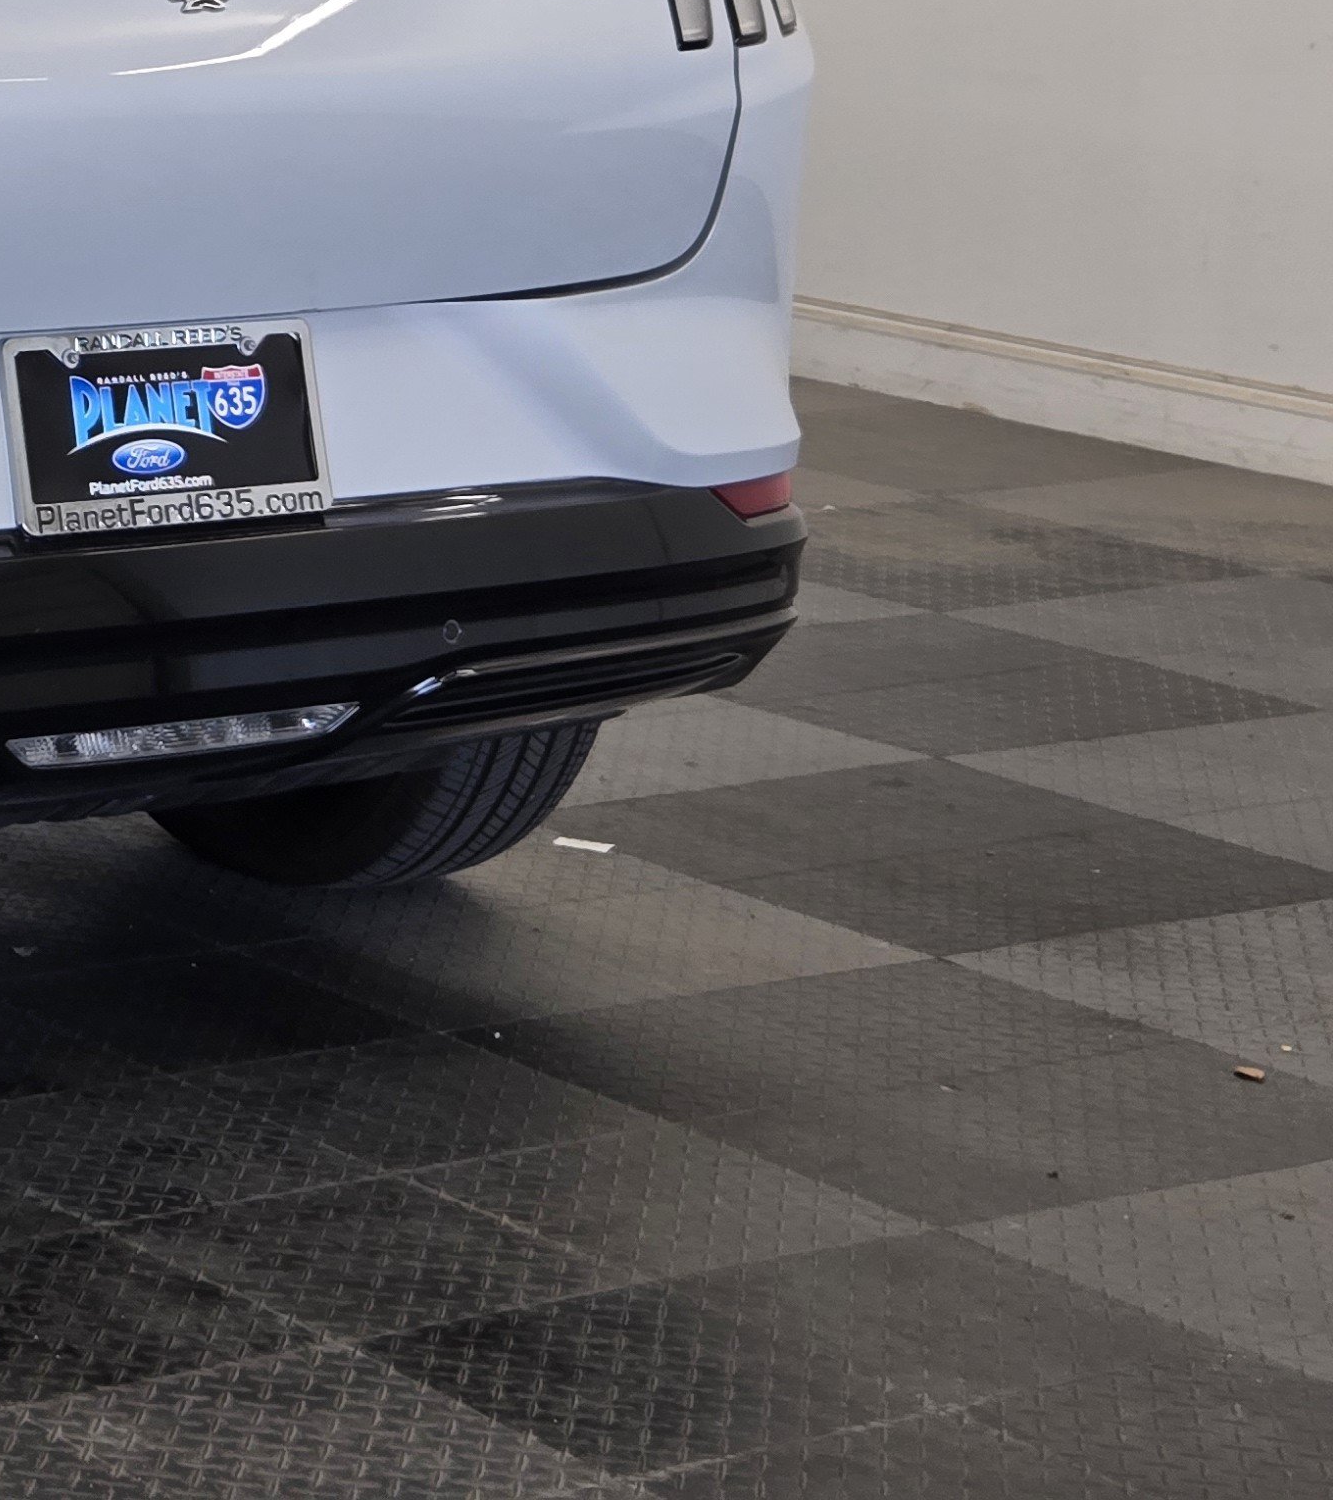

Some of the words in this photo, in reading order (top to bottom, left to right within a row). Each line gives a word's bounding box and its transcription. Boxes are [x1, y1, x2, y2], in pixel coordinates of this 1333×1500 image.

[74, 331, 169, 351] RANDALL
[171, 325, 242, 346] REED'S
[69, 375, 212, 447] PLANET
[214, 385, 257, 417] 635
[126, 446, 171, 469] Ford
[89, 474, 213, 495] PlanetFord635.com
[36, 489, 324, 534] PlanetFord635.com
